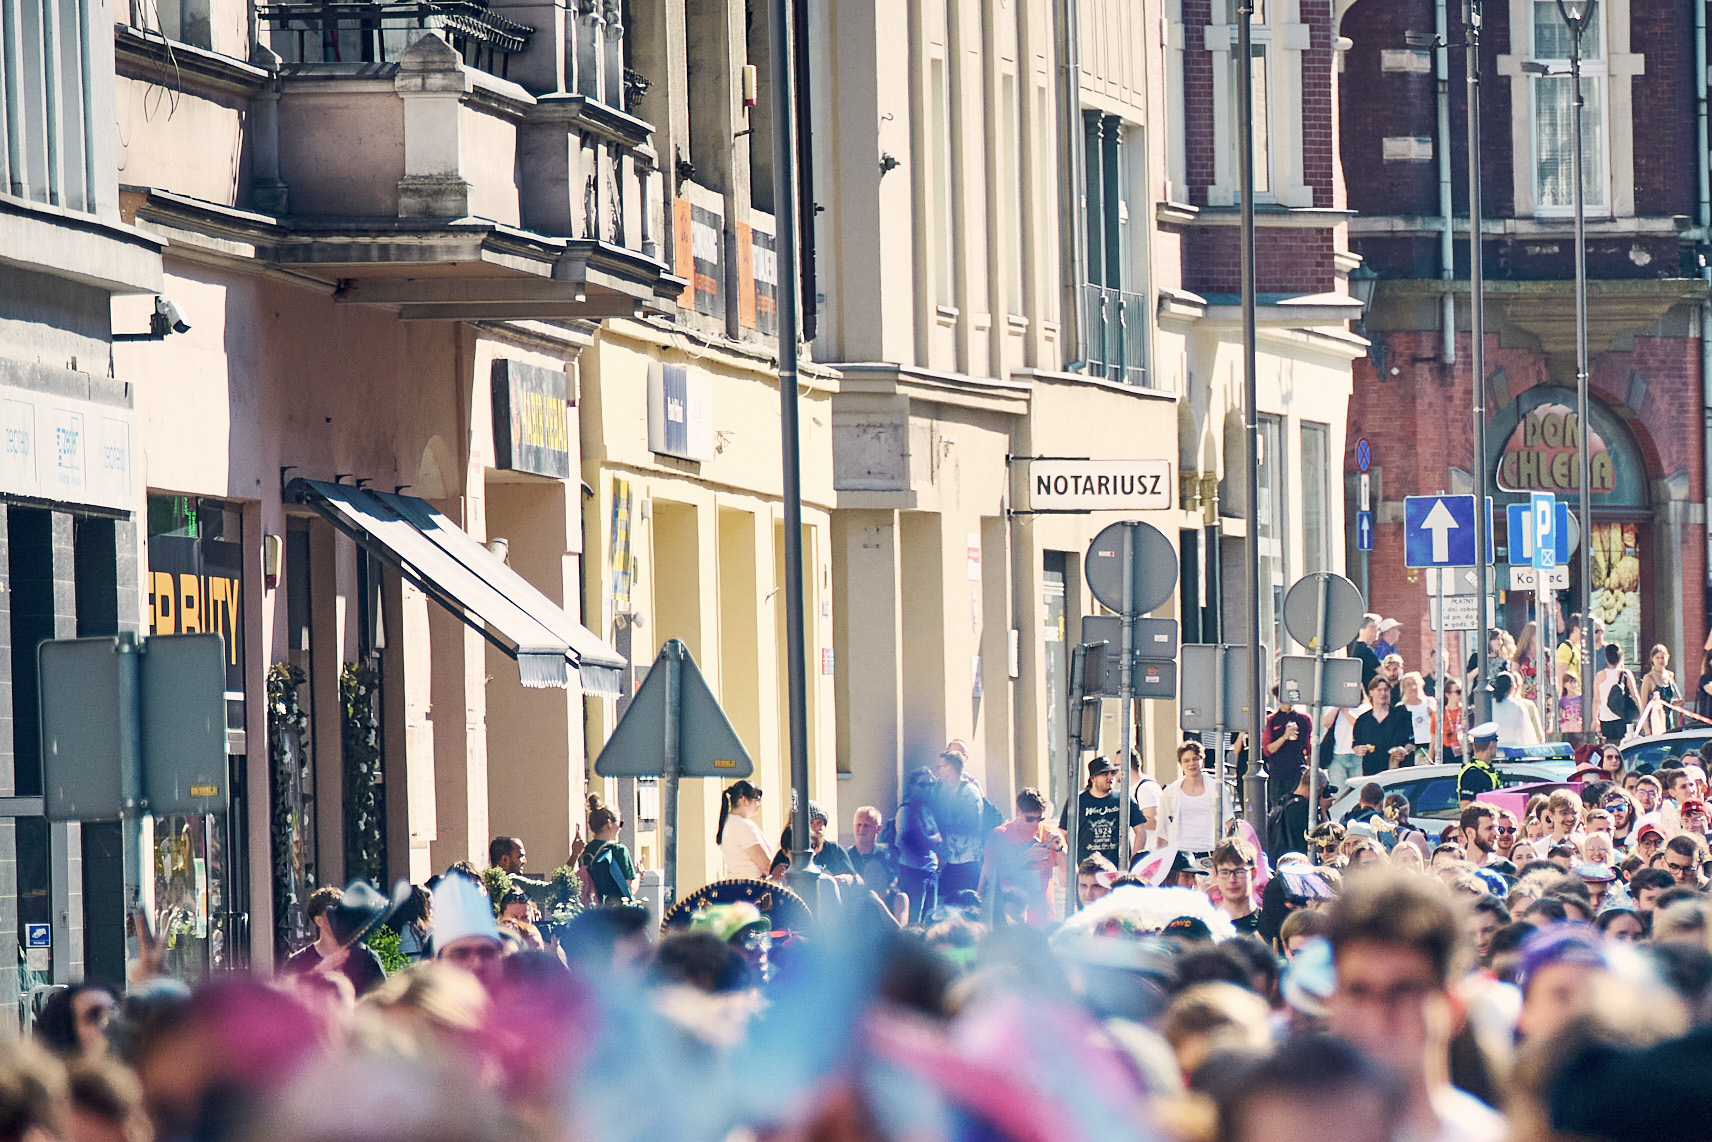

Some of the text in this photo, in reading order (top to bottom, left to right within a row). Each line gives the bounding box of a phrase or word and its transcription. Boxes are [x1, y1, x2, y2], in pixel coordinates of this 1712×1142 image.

[1037, 475, 1162, 495] NOTARIUSZ
[1536, 500, 1551, 548] P
[1517, 572, 1563, 585] Koec
